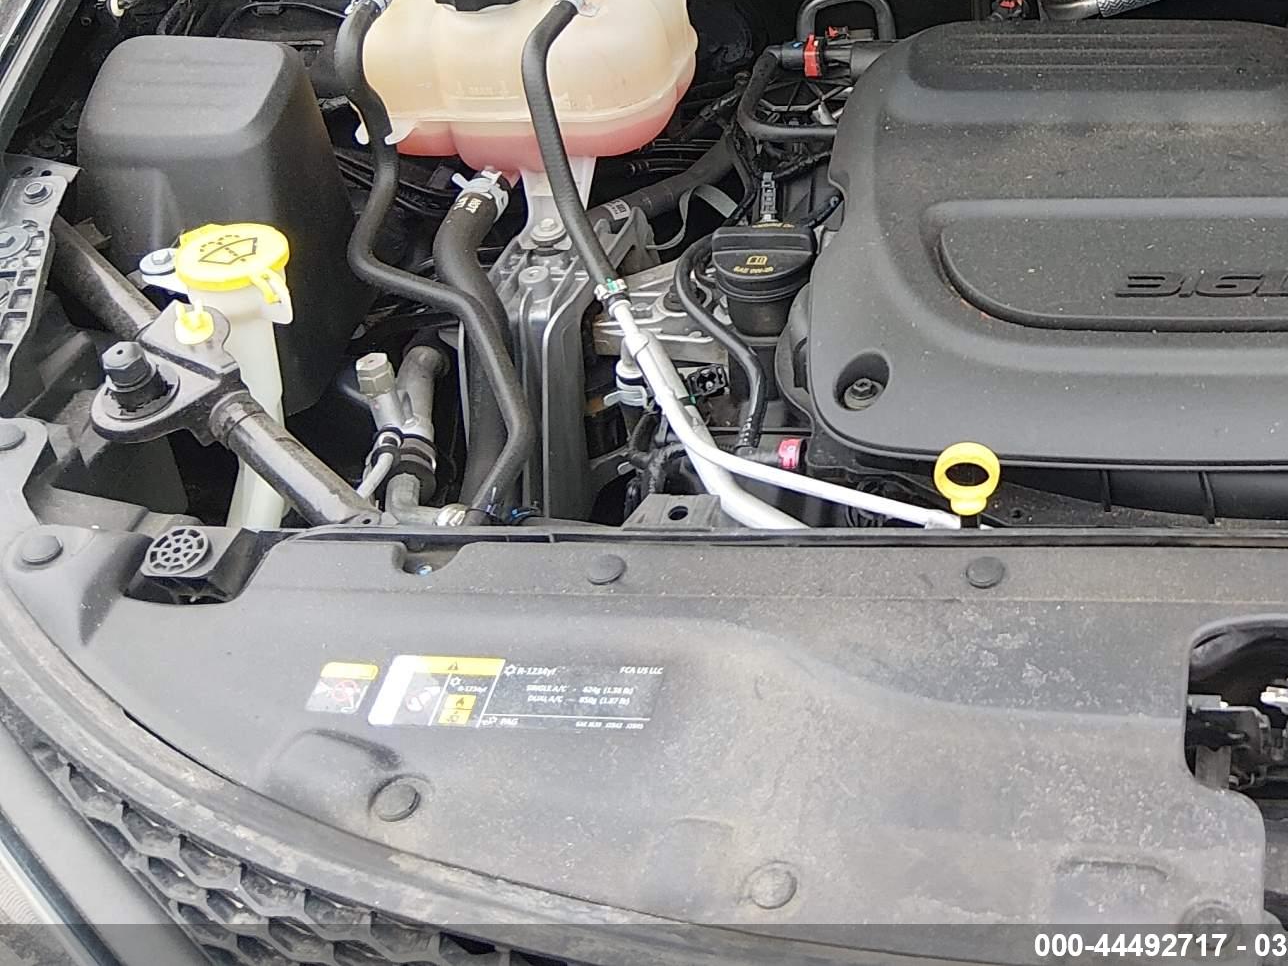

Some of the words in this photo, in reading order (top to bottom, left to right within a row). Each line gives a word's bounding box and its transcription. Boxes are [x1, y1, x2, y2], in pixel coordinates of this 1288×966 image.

[517, 666, 557, 677] R-1234yf
[620, 666, 636, 675] FCA
[636, 666, 650, 675] US
[649, 666, 665, 675] LLC
